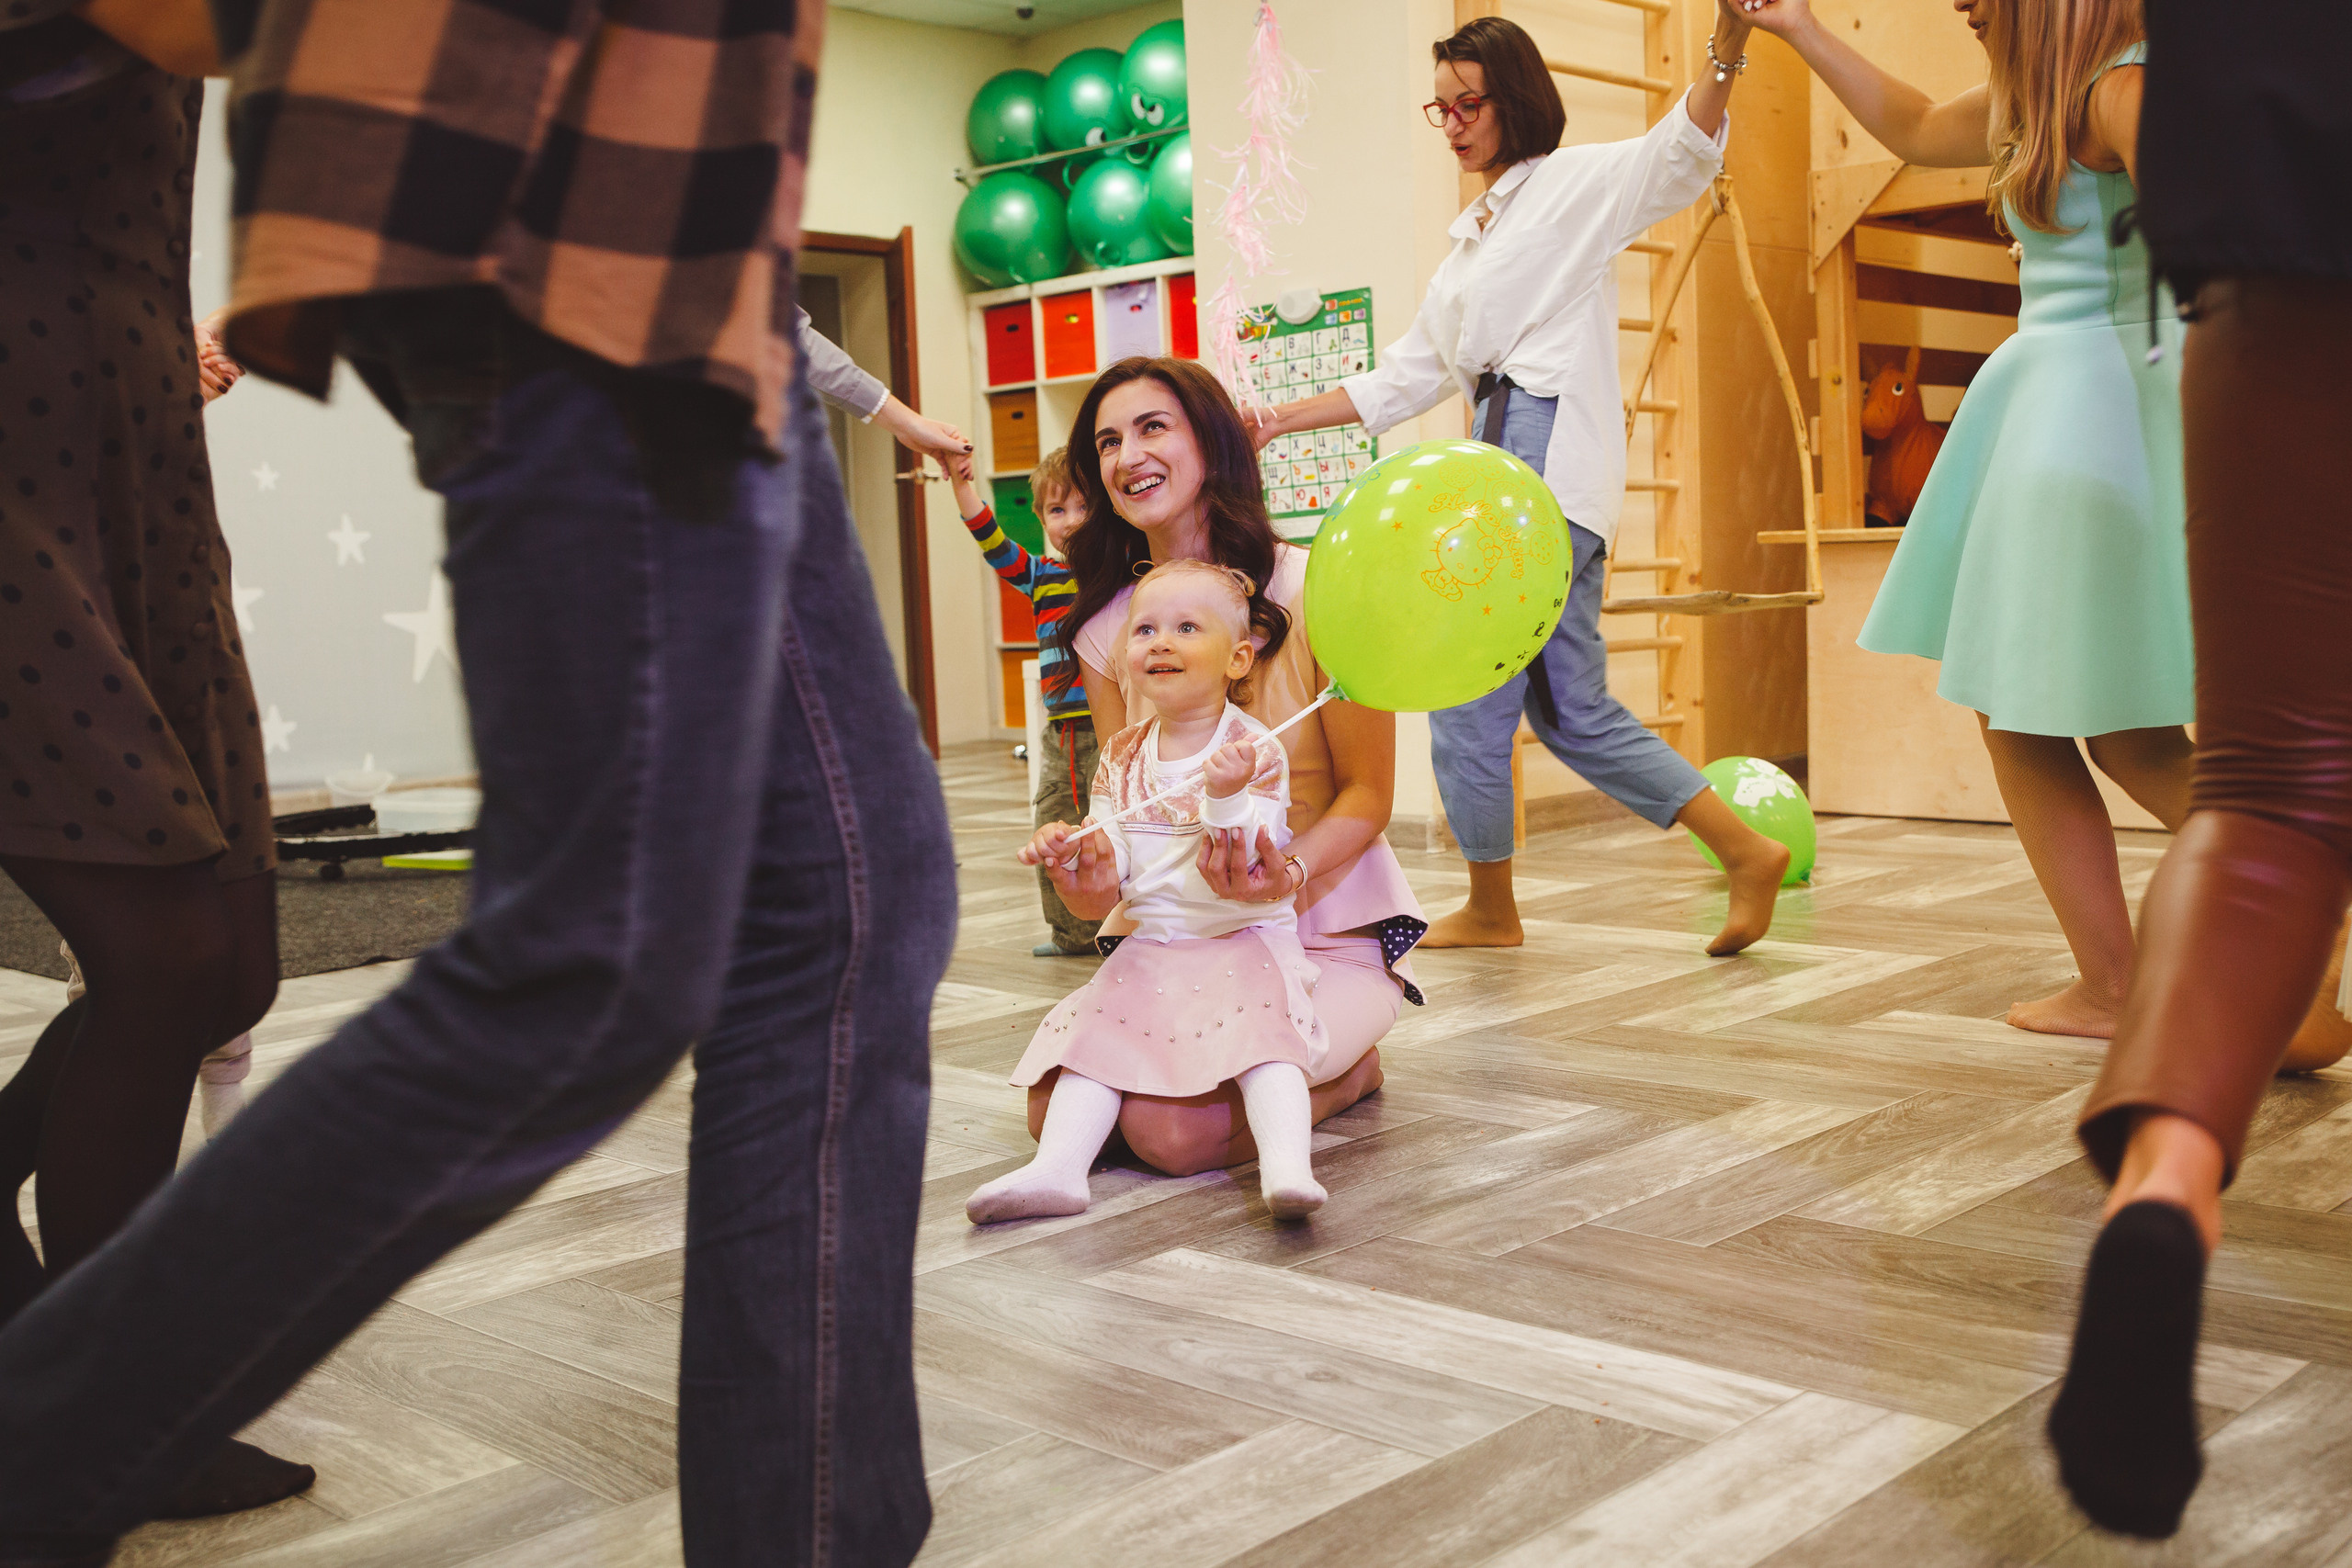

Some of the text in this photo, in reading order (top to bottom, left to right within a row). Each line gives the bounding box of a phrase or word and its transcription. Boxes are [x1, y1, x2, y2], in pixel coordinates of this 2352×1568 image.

[1288, 337, 1295, 349] В
[1342, 328, 1350, 343] Д
[1289, 364, 1297, 374] Ж
[1317, 384, 1325, 395] М
[1268, 432, 1353, 453] Ф Х Ц Ч
[1319, 461, 1329, 472] Ы
[1295, 489, 1306, 501] Ю
[1323, 487, 1330, 498] Я
[1429, 493, 1524, 580] Hello Kitty
